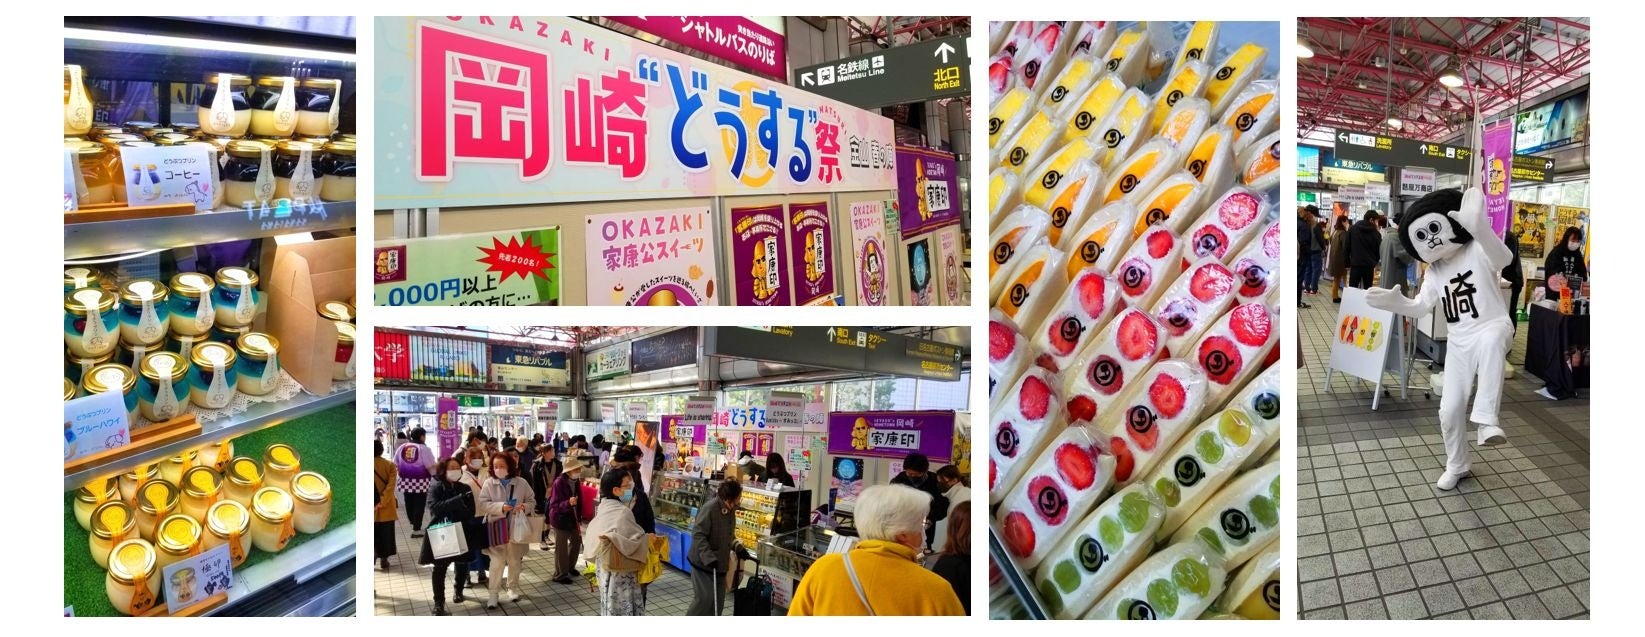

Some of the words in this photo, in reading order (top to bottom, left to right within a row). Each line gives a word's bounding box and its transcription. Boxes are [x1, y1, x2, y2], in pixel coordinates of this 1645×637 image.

[681, 16, 776, 67] シャトルバスのりば
[837, 59, 870, 76] 名鉄線
[837, 72, 867, 83] Meitetsu
[869, 68, 885, 77] Line
[933, 67, 960, 83] 北口
[934, 81, 949, 91] North
[949, 79, 961, 89] Exit
[1341, 160, 1374, 171] 東急リバブル
[165, 170, 201, 180] コーヒー
[602, 213, 703, 242] OKAZAKI
[603, 238, 704, 272] 家康公スイーツ
[1442, 270, 1480, 324] 崎
[868, 333, 887, 344] タクシー
[515, 354, 553, 367] 東急リバブル
[76, 407, 112, 421] どうぶつプリン
[77, 417, 121, 435] ブルーハワイ
[871, 432, 915, 448] 家康印
